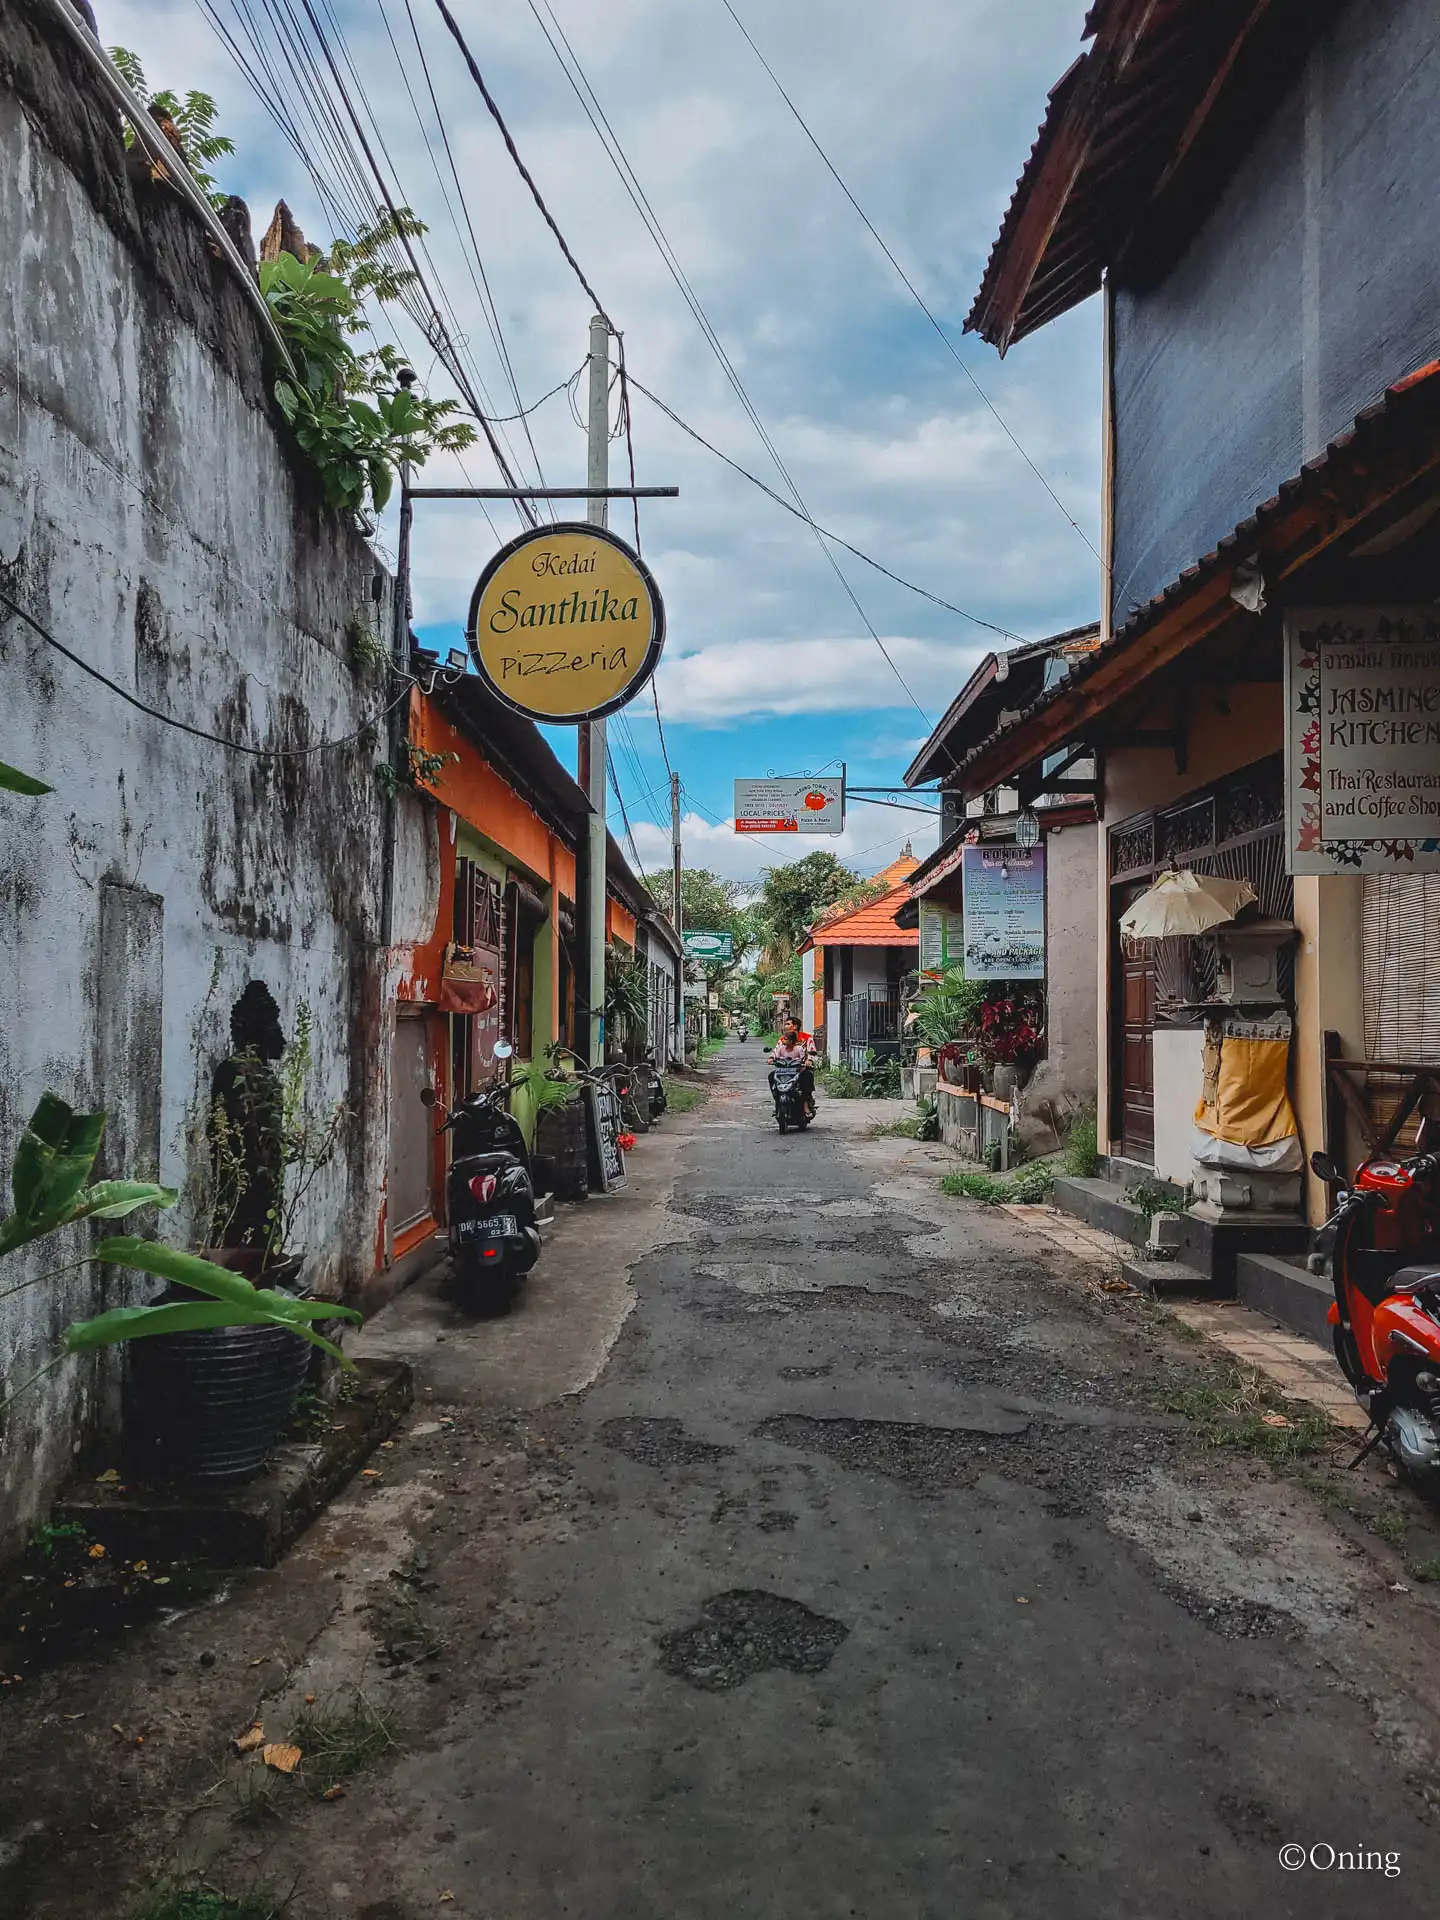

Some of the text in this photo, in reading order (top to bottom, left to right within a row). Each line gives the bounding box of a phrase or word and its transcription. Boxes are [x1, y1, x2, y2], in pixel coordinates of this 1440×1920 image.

[531, 551, 596, 576] Kedai
[489, 588, 640, 634] Santhika
[1328, 719, 1440, 747] KITCHEN
[1327, 768, 1361, 790] Thai
[1325, 796, 1355, 816] and
[1358, 795, 1406, 818] Coffee
